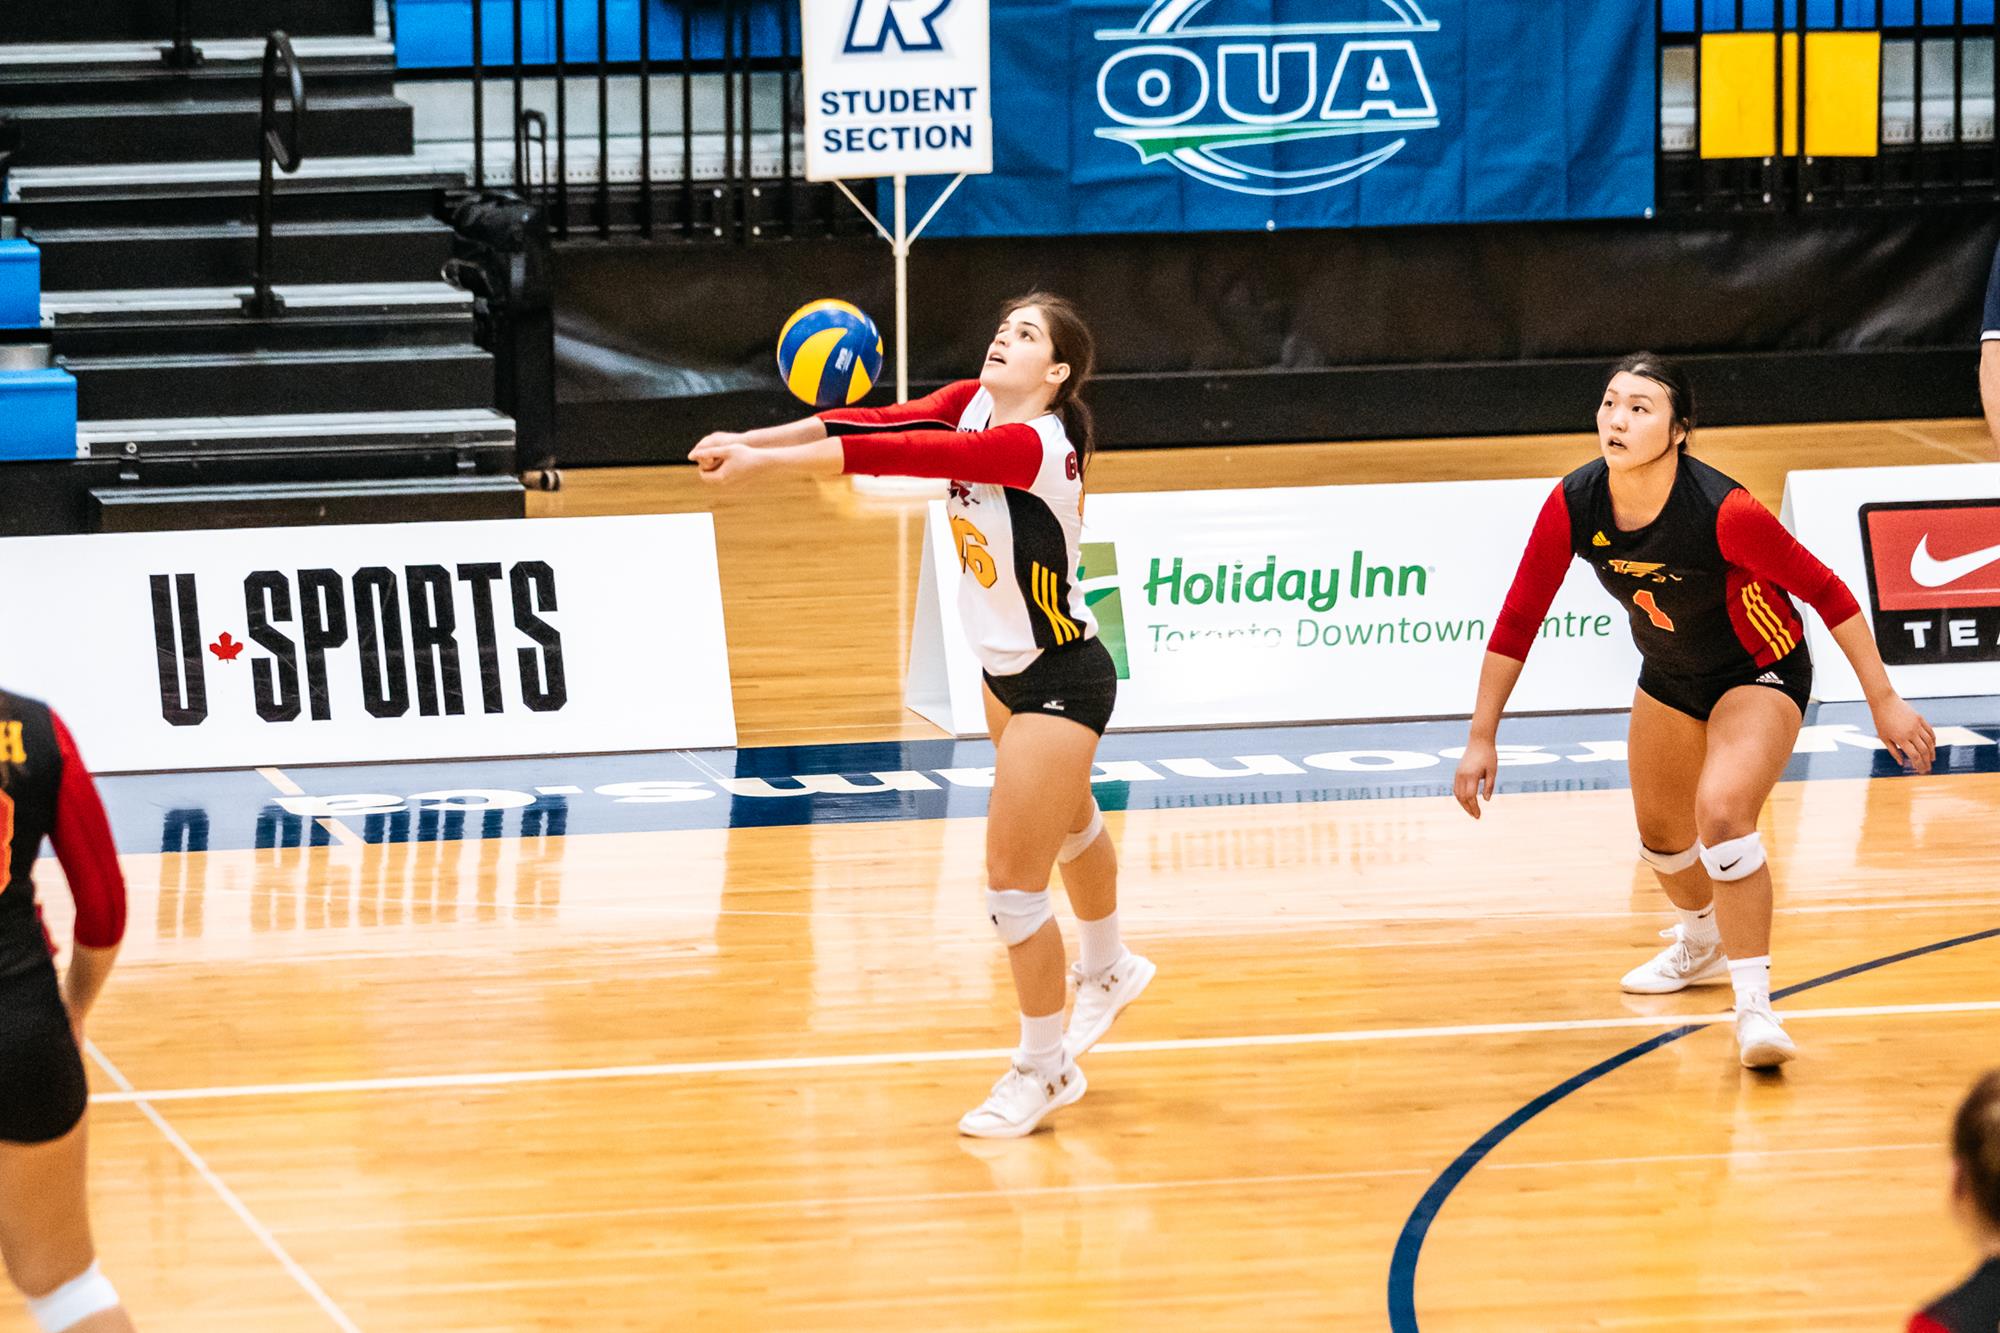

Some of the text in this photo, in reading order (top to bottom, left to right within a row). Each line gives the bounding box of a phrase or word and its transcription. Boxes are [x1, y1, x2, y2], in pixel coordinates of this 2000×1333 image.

[821, 86, 977, 115] STUDENT
[1096, 40, 1438, 127] OUA
[824, 125, 972, 152] SECTION
[1143, 550, 1427, 612] Holiday Inn
[149, 560, 568, 726] U SPORTS
[1297, 617, 1485, 647] Downtown
[1542, 611, 1612, 638] ntre
[1903, 619, 2000, 649] TE
